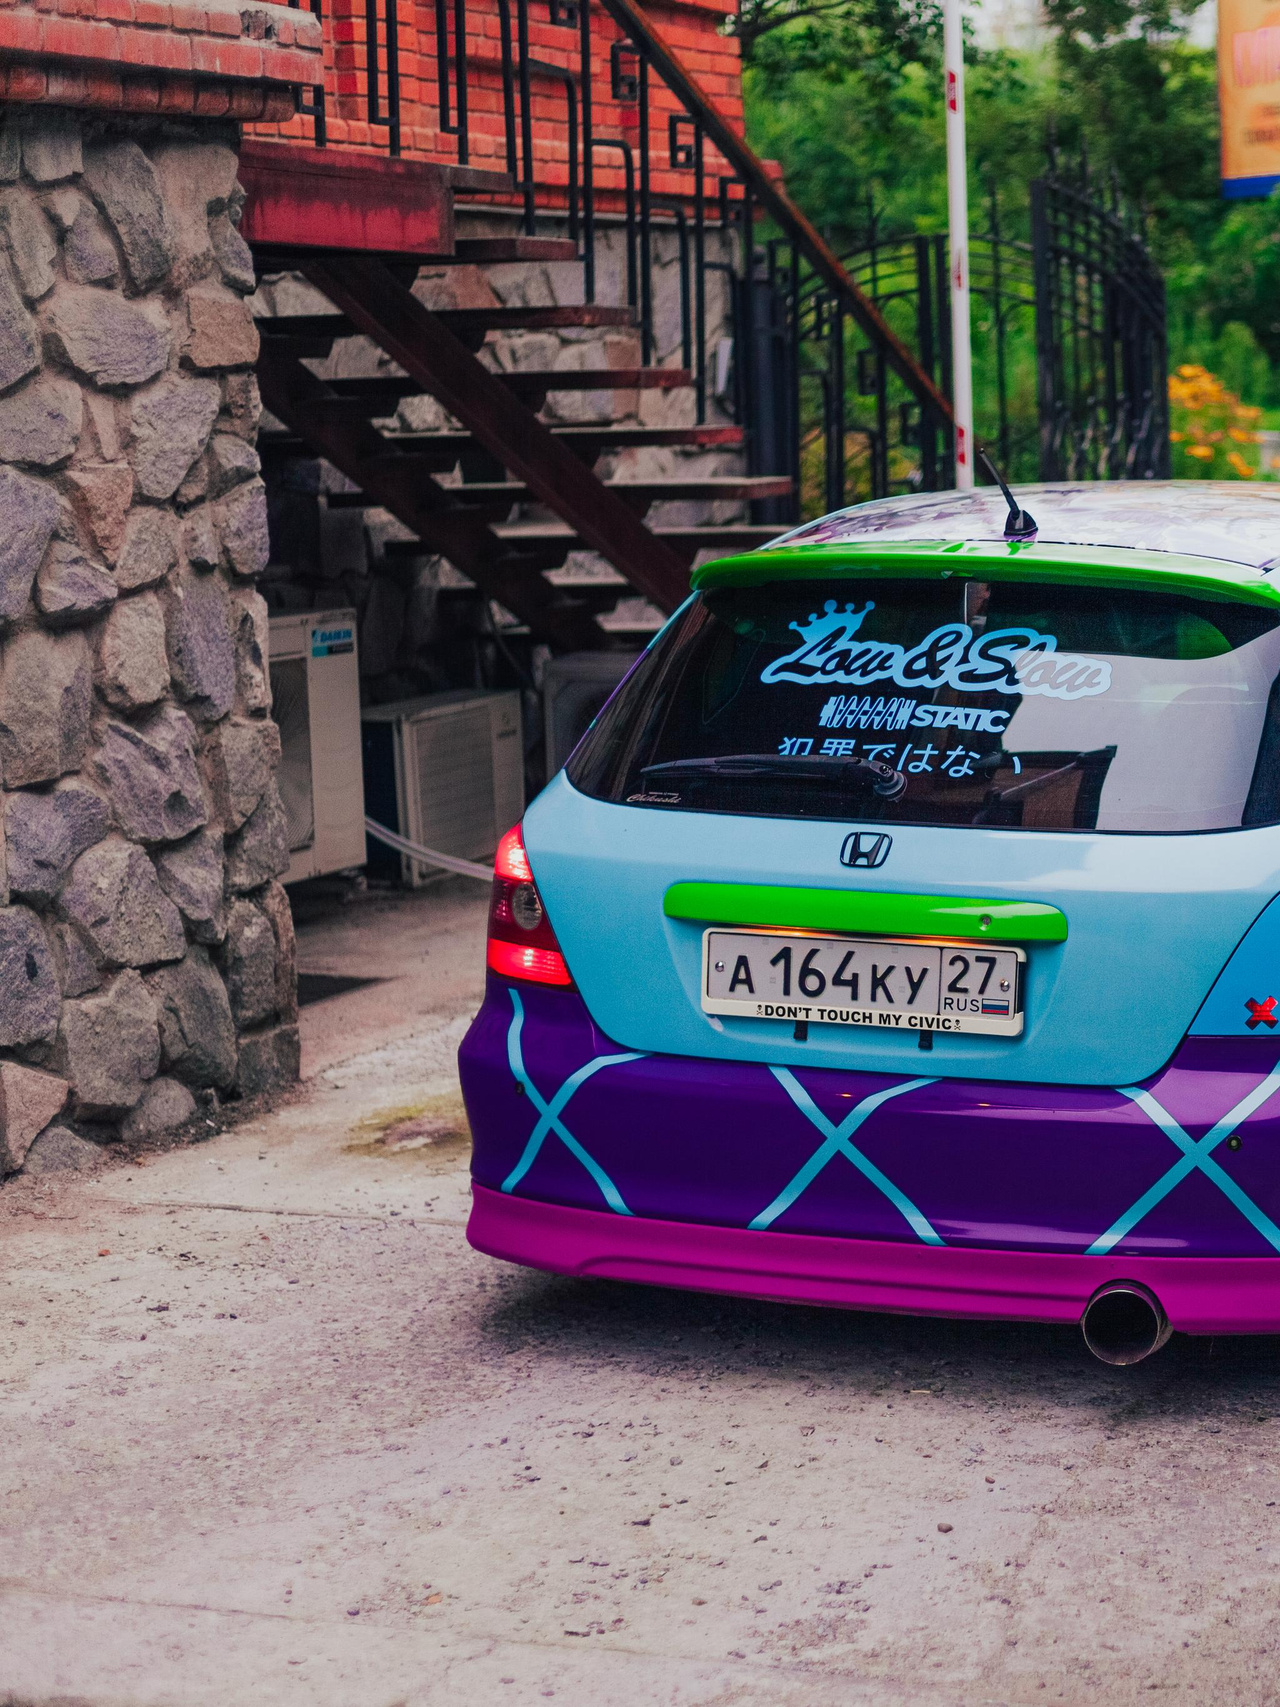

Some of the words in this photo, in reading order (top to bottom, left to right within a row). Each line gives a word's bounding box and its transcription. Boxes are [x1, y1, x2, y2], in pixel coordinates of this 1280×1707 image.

[910, 704, 1011, 734] STATIC
[947, 954, 998, 996] 27
[764, 1004, 812, 1020] DON'T
[817, 1008, 873, 1024] TOUCH
[879, 1013, 903, 1026] MY
[908, 1016, 952, 1030] CIVIC
[943, 997, 980, 1013] RUS
